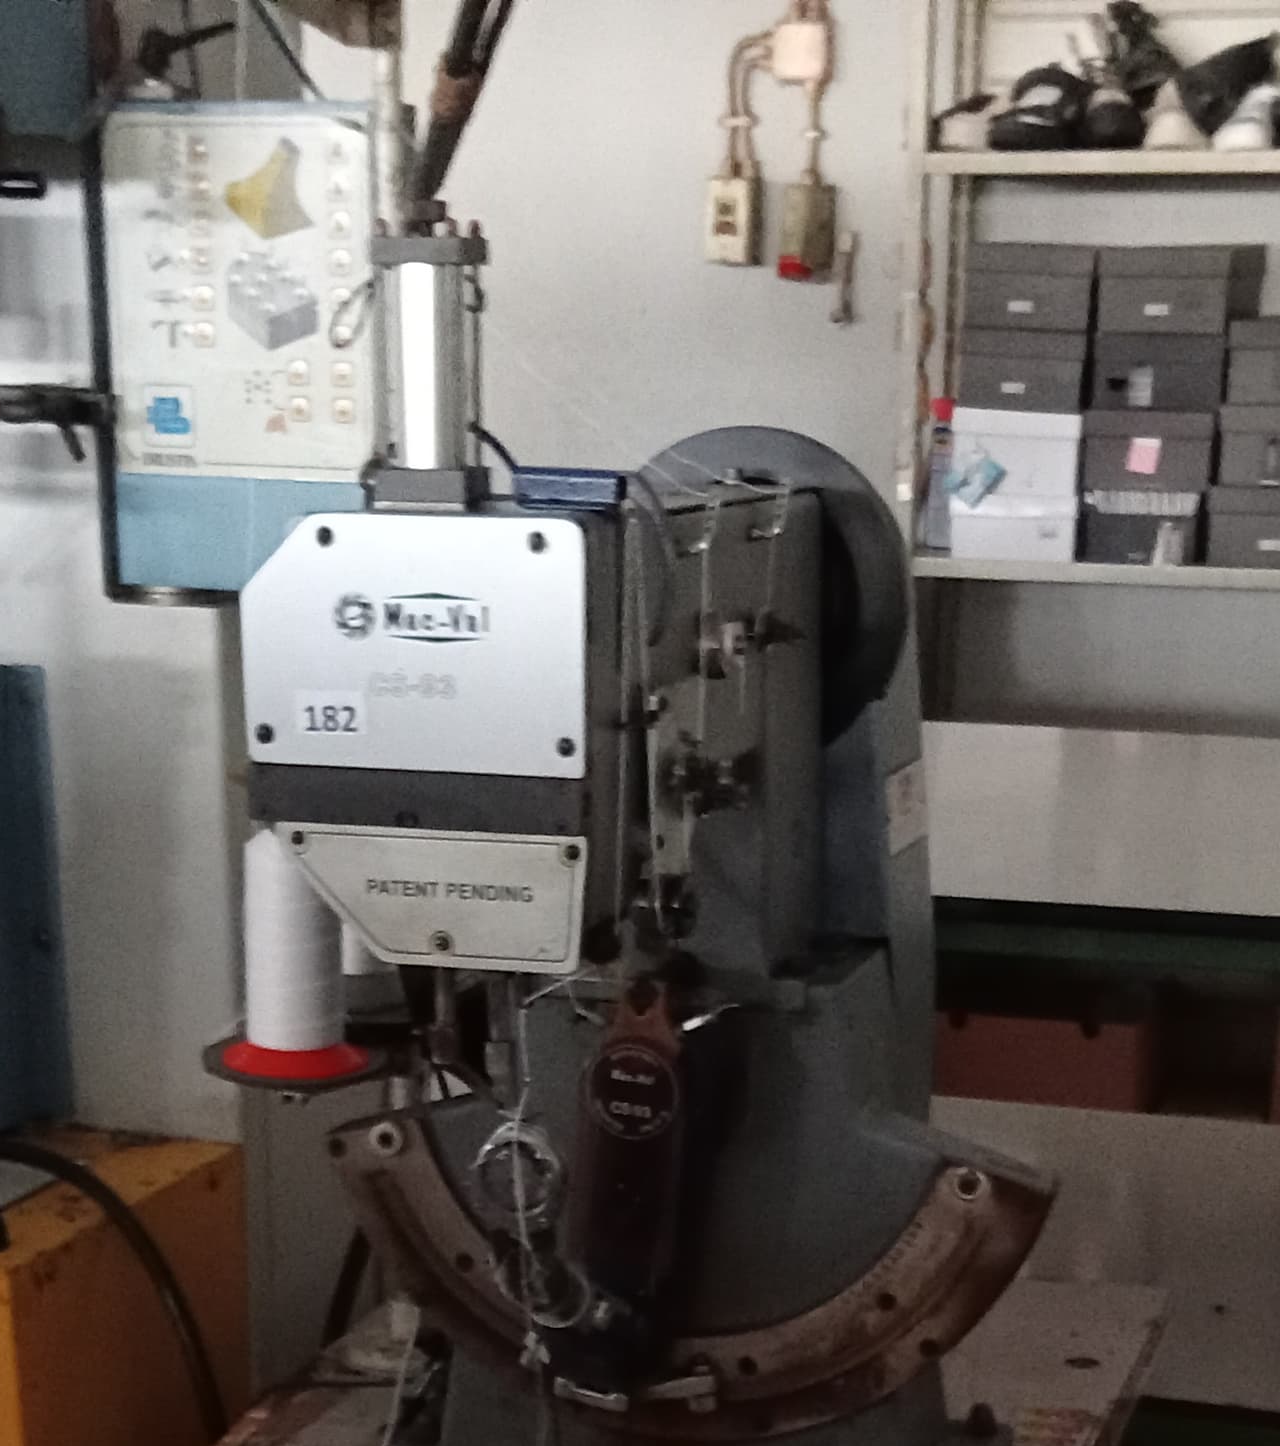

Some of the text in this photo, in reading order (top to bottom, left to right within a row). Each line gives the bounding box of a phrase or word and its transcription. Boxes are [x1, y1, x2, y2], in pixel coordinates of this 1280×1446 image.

[304, 705, 358, 732] 182
[367, 878, 534, 903] PATENT PENDING
